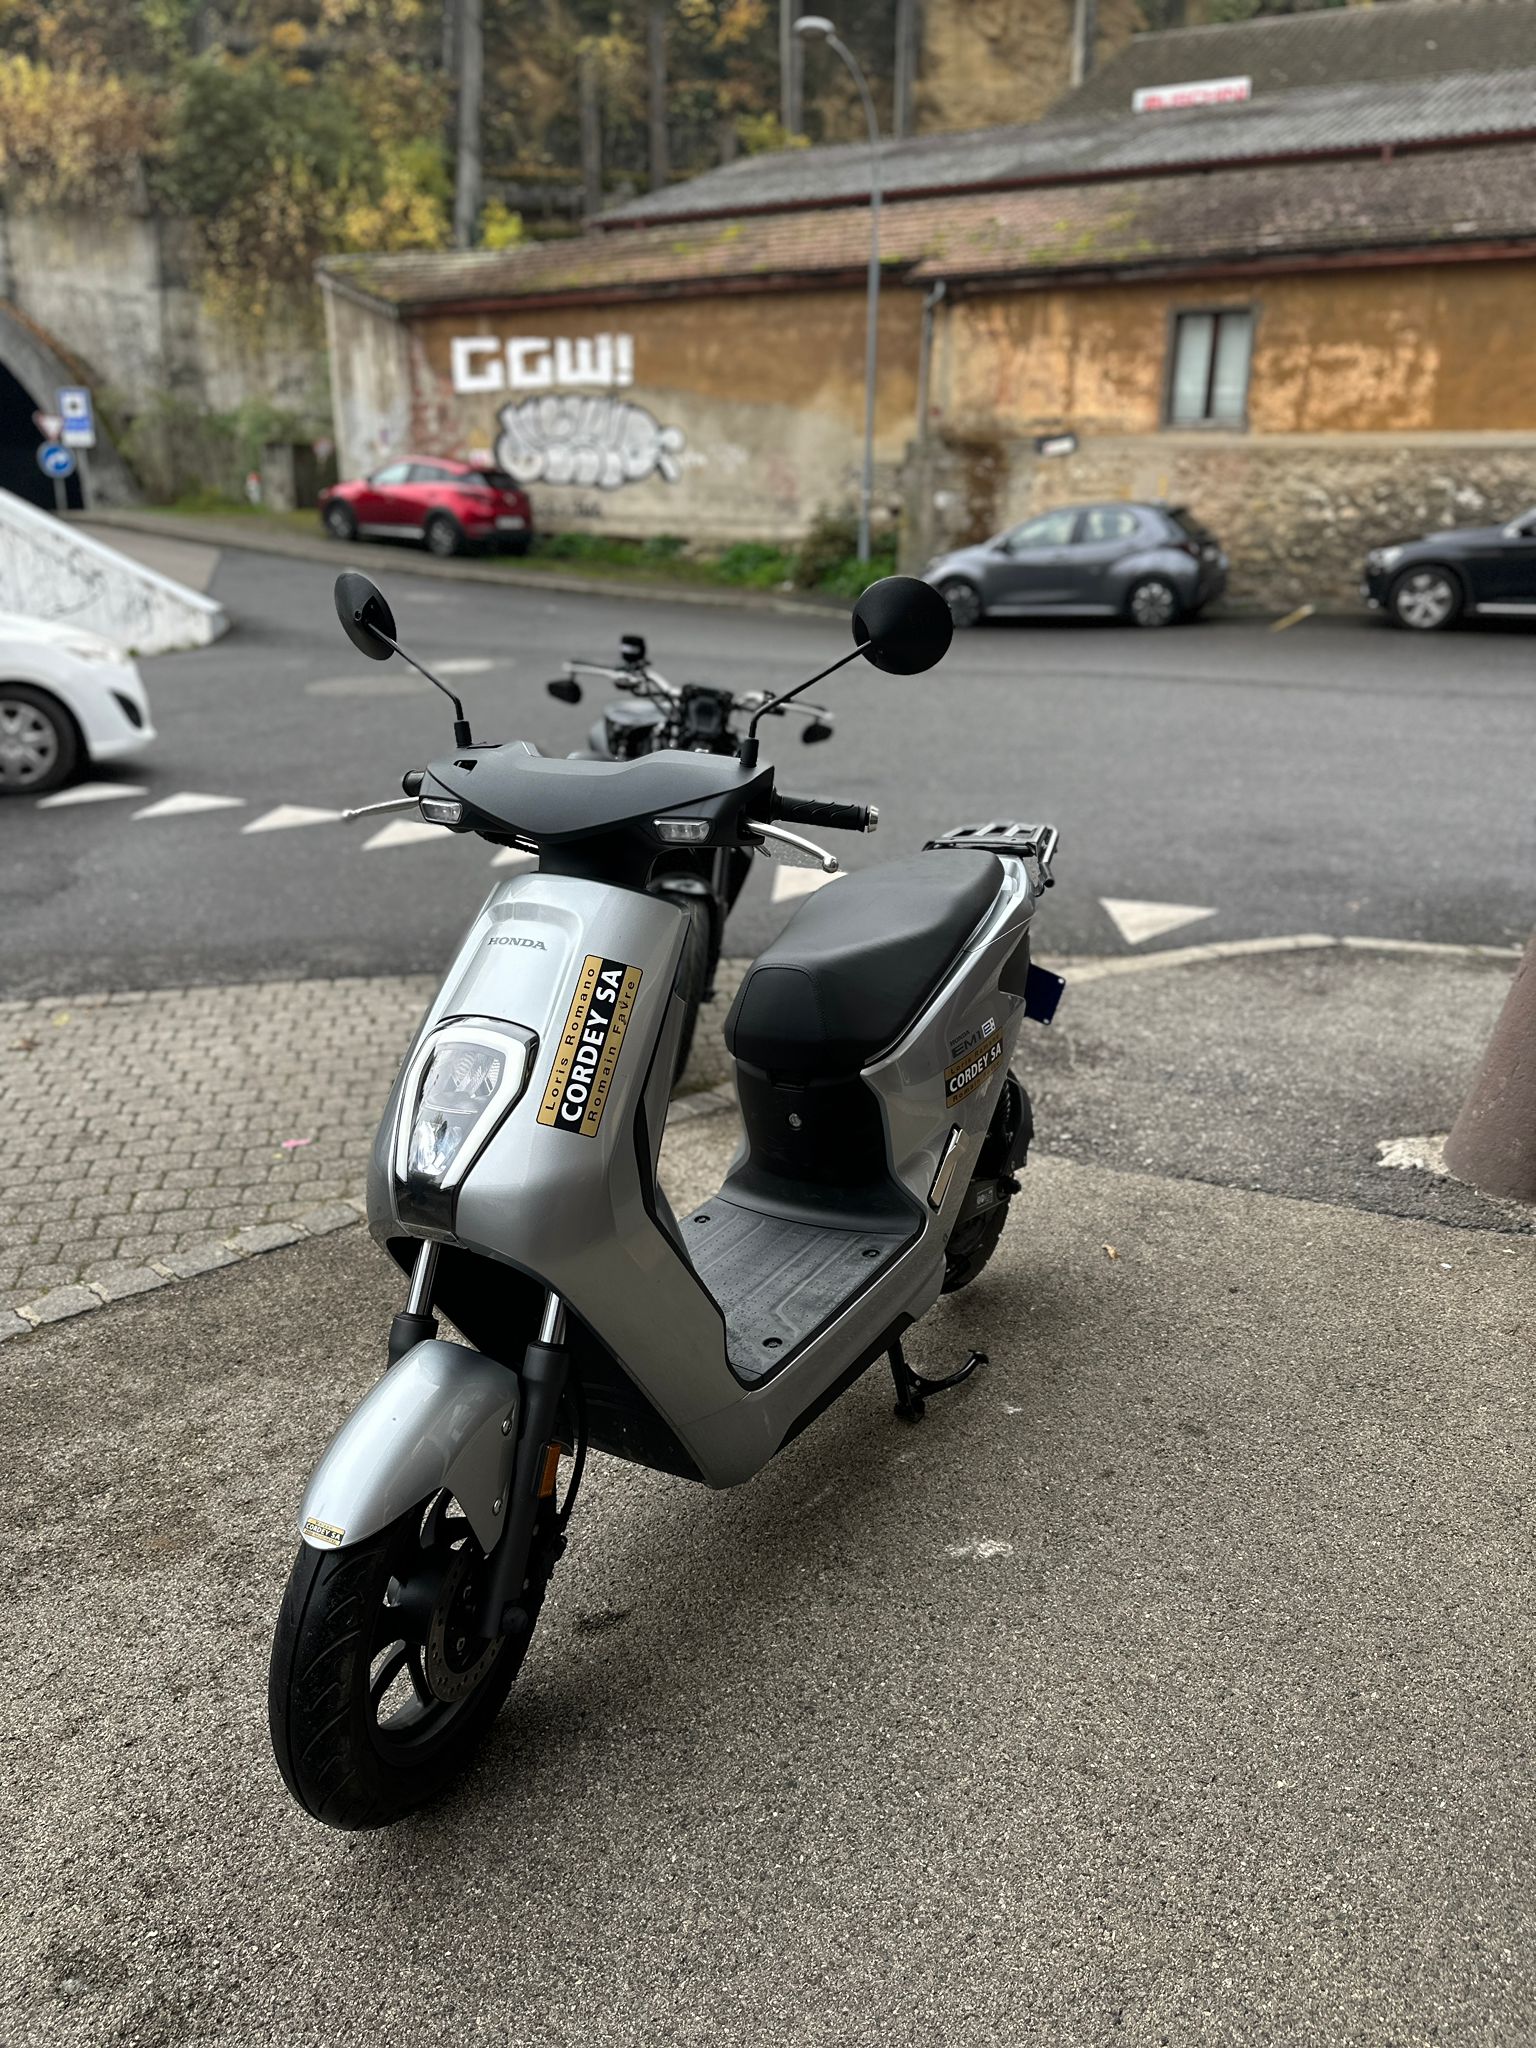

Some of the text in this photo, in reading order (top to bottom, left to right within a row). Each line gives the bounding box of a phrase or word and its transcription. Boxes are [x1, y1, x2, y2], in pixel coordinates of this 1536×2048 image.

[487, 936, 548, 951] HONDA
[545, 968, 595, 1111] Loris Romano
[561, 969, 623, 1122] CORDEY SA
[587, 980, 635, 1122] Romain Favre
[951, 1030, 982, 1059] EM1
[949, 1053, 989, 1093] CORDEY
[990, 1042, 1002, 1061] SA
[305, 1523, 331, 1536] CORDEY
[331, 1532, 341, 1541] SA
